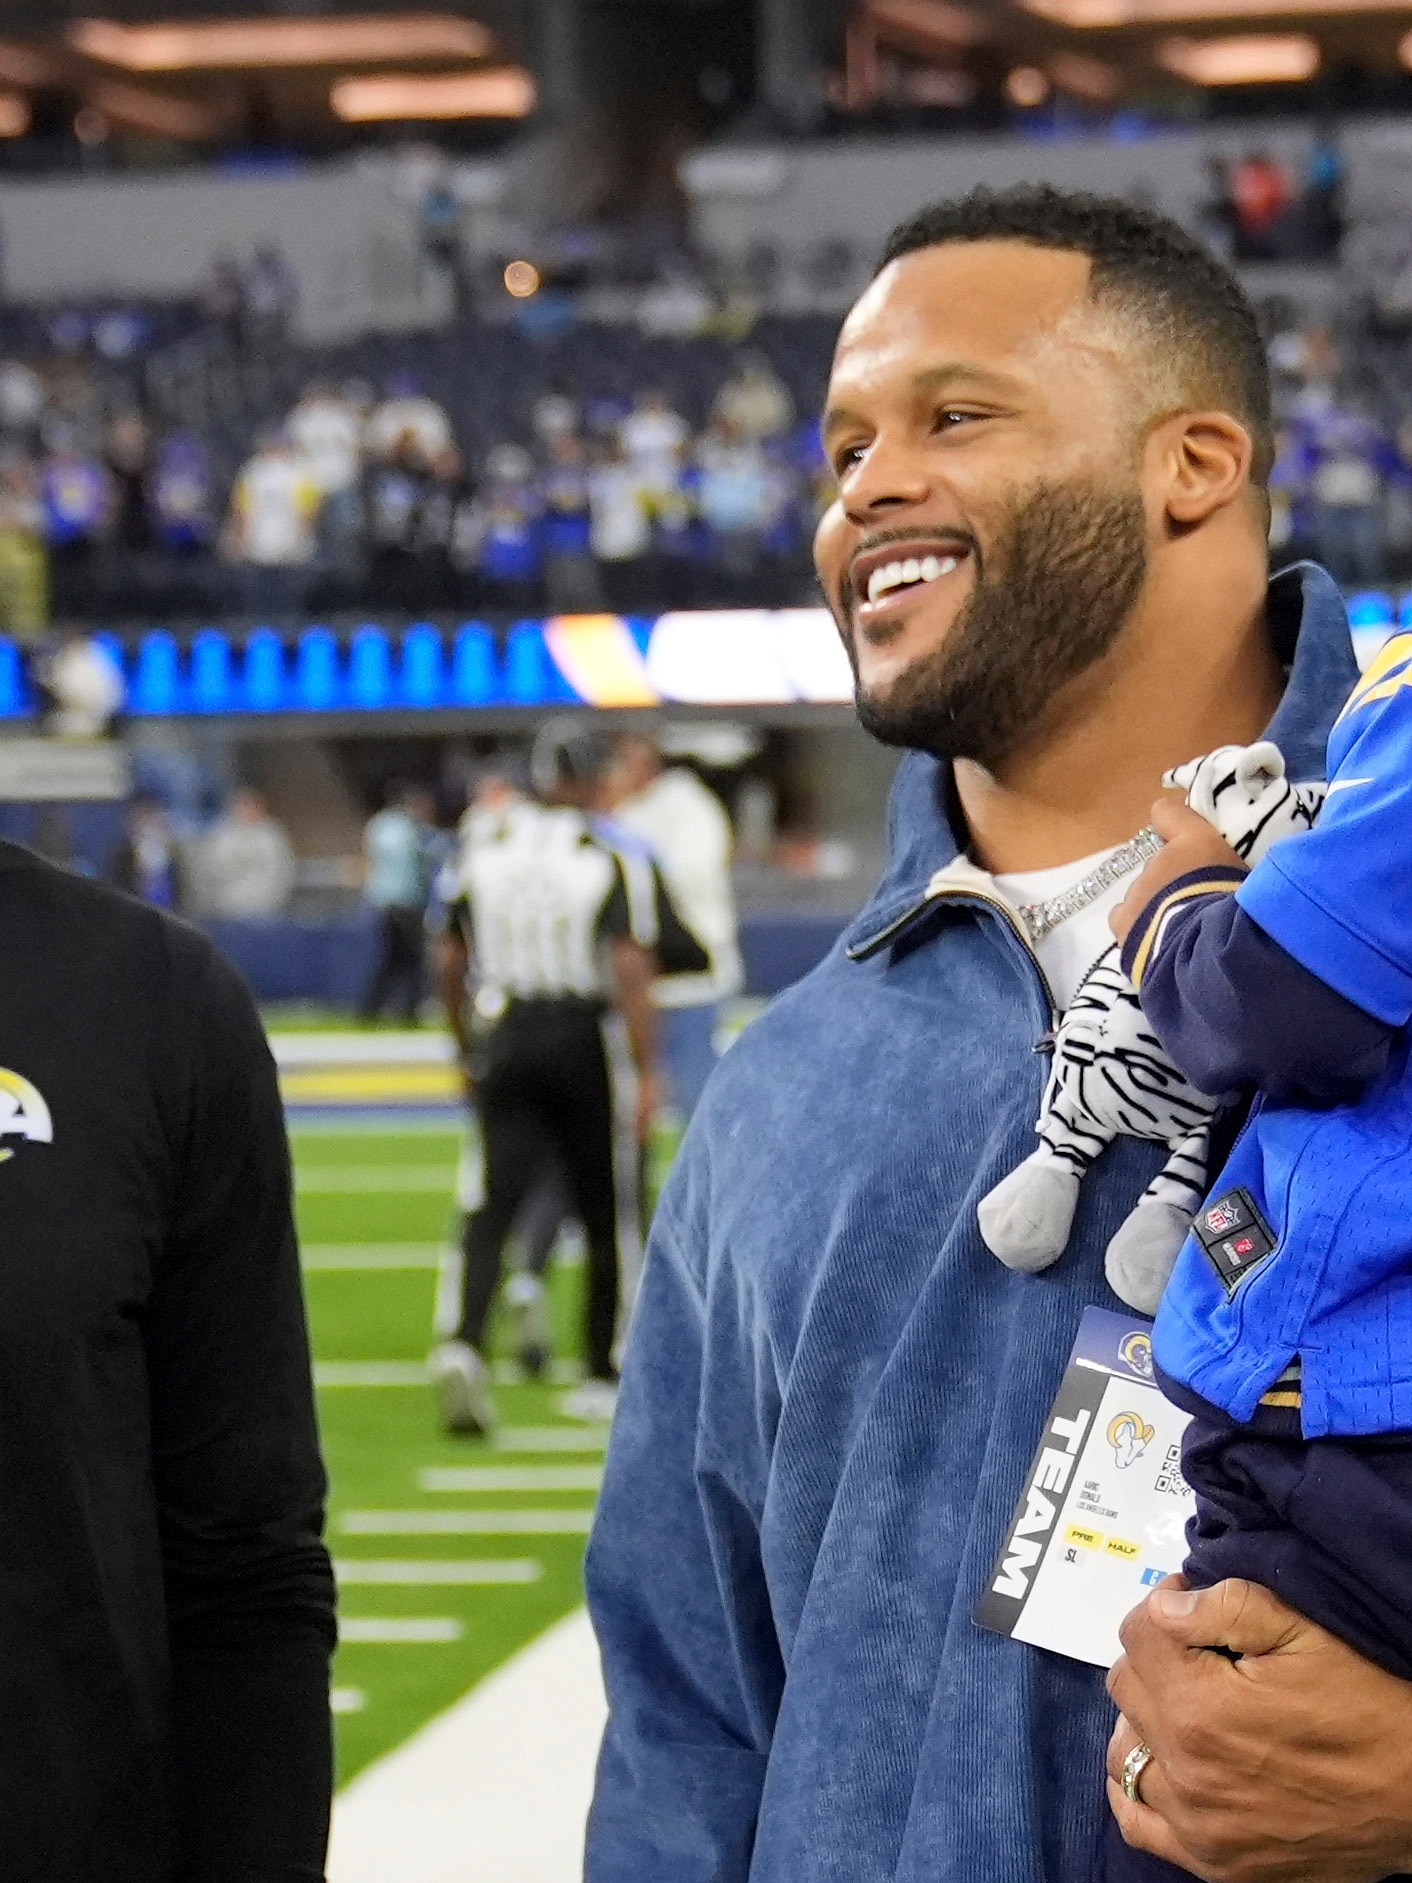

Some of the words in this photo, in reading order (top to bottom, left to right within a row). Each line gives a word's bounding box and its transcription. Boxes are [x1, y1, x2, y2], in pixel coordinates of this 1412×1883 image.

[991, 1408, 1092, 1600] TEAM
[1071, 1530, 1094, 1543] PRE
[1107, 1541, 1136, 1554] HALF
